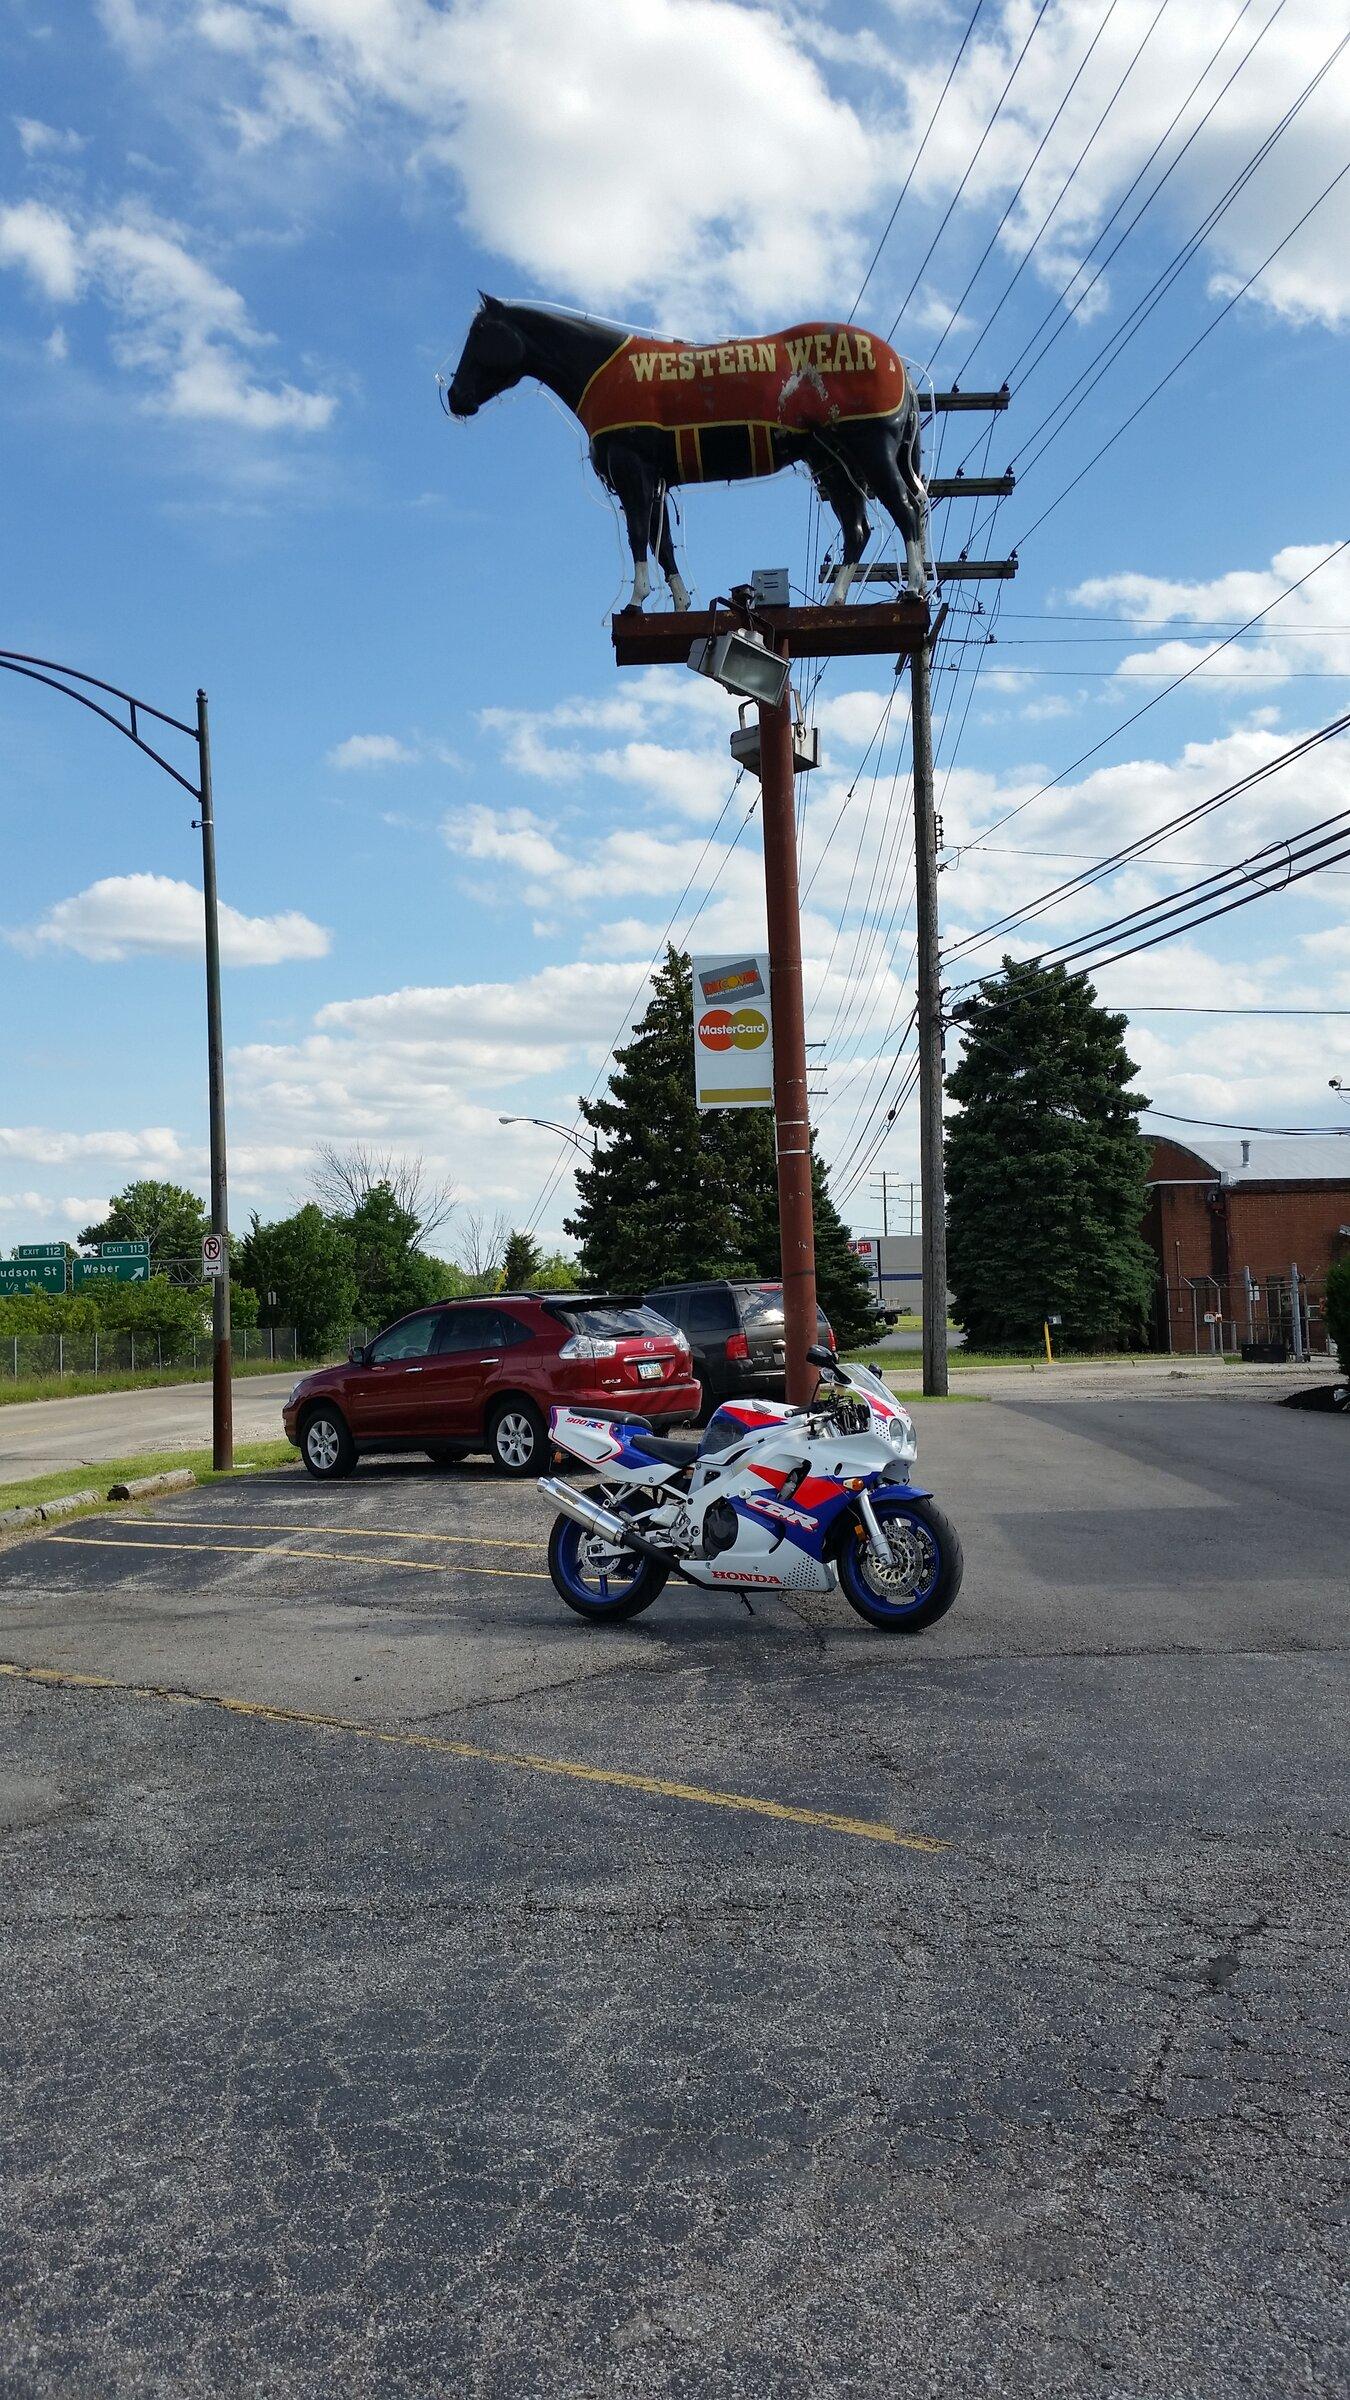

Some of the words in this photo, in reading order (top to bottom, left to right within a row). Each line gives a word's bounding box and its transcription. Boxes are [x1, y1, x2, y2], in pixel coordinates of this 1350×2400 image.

[629, 343, 777, 382] WESTERN
[785, 333, 877, 376] WEAR
[700, 1023, 765, 1035] MasterCard
[22, 1248, 40, 1256] EXIT
[46, 1246, 61, 1256] 112
[130, 1244, 145, 1253] 113
[43, 1266, 57, 1276] St
[83, 1264, 120, 1274] Weber
[745, 1494, 820, 1534] CBR
[711, 1570, 783, 1585] HONDA
